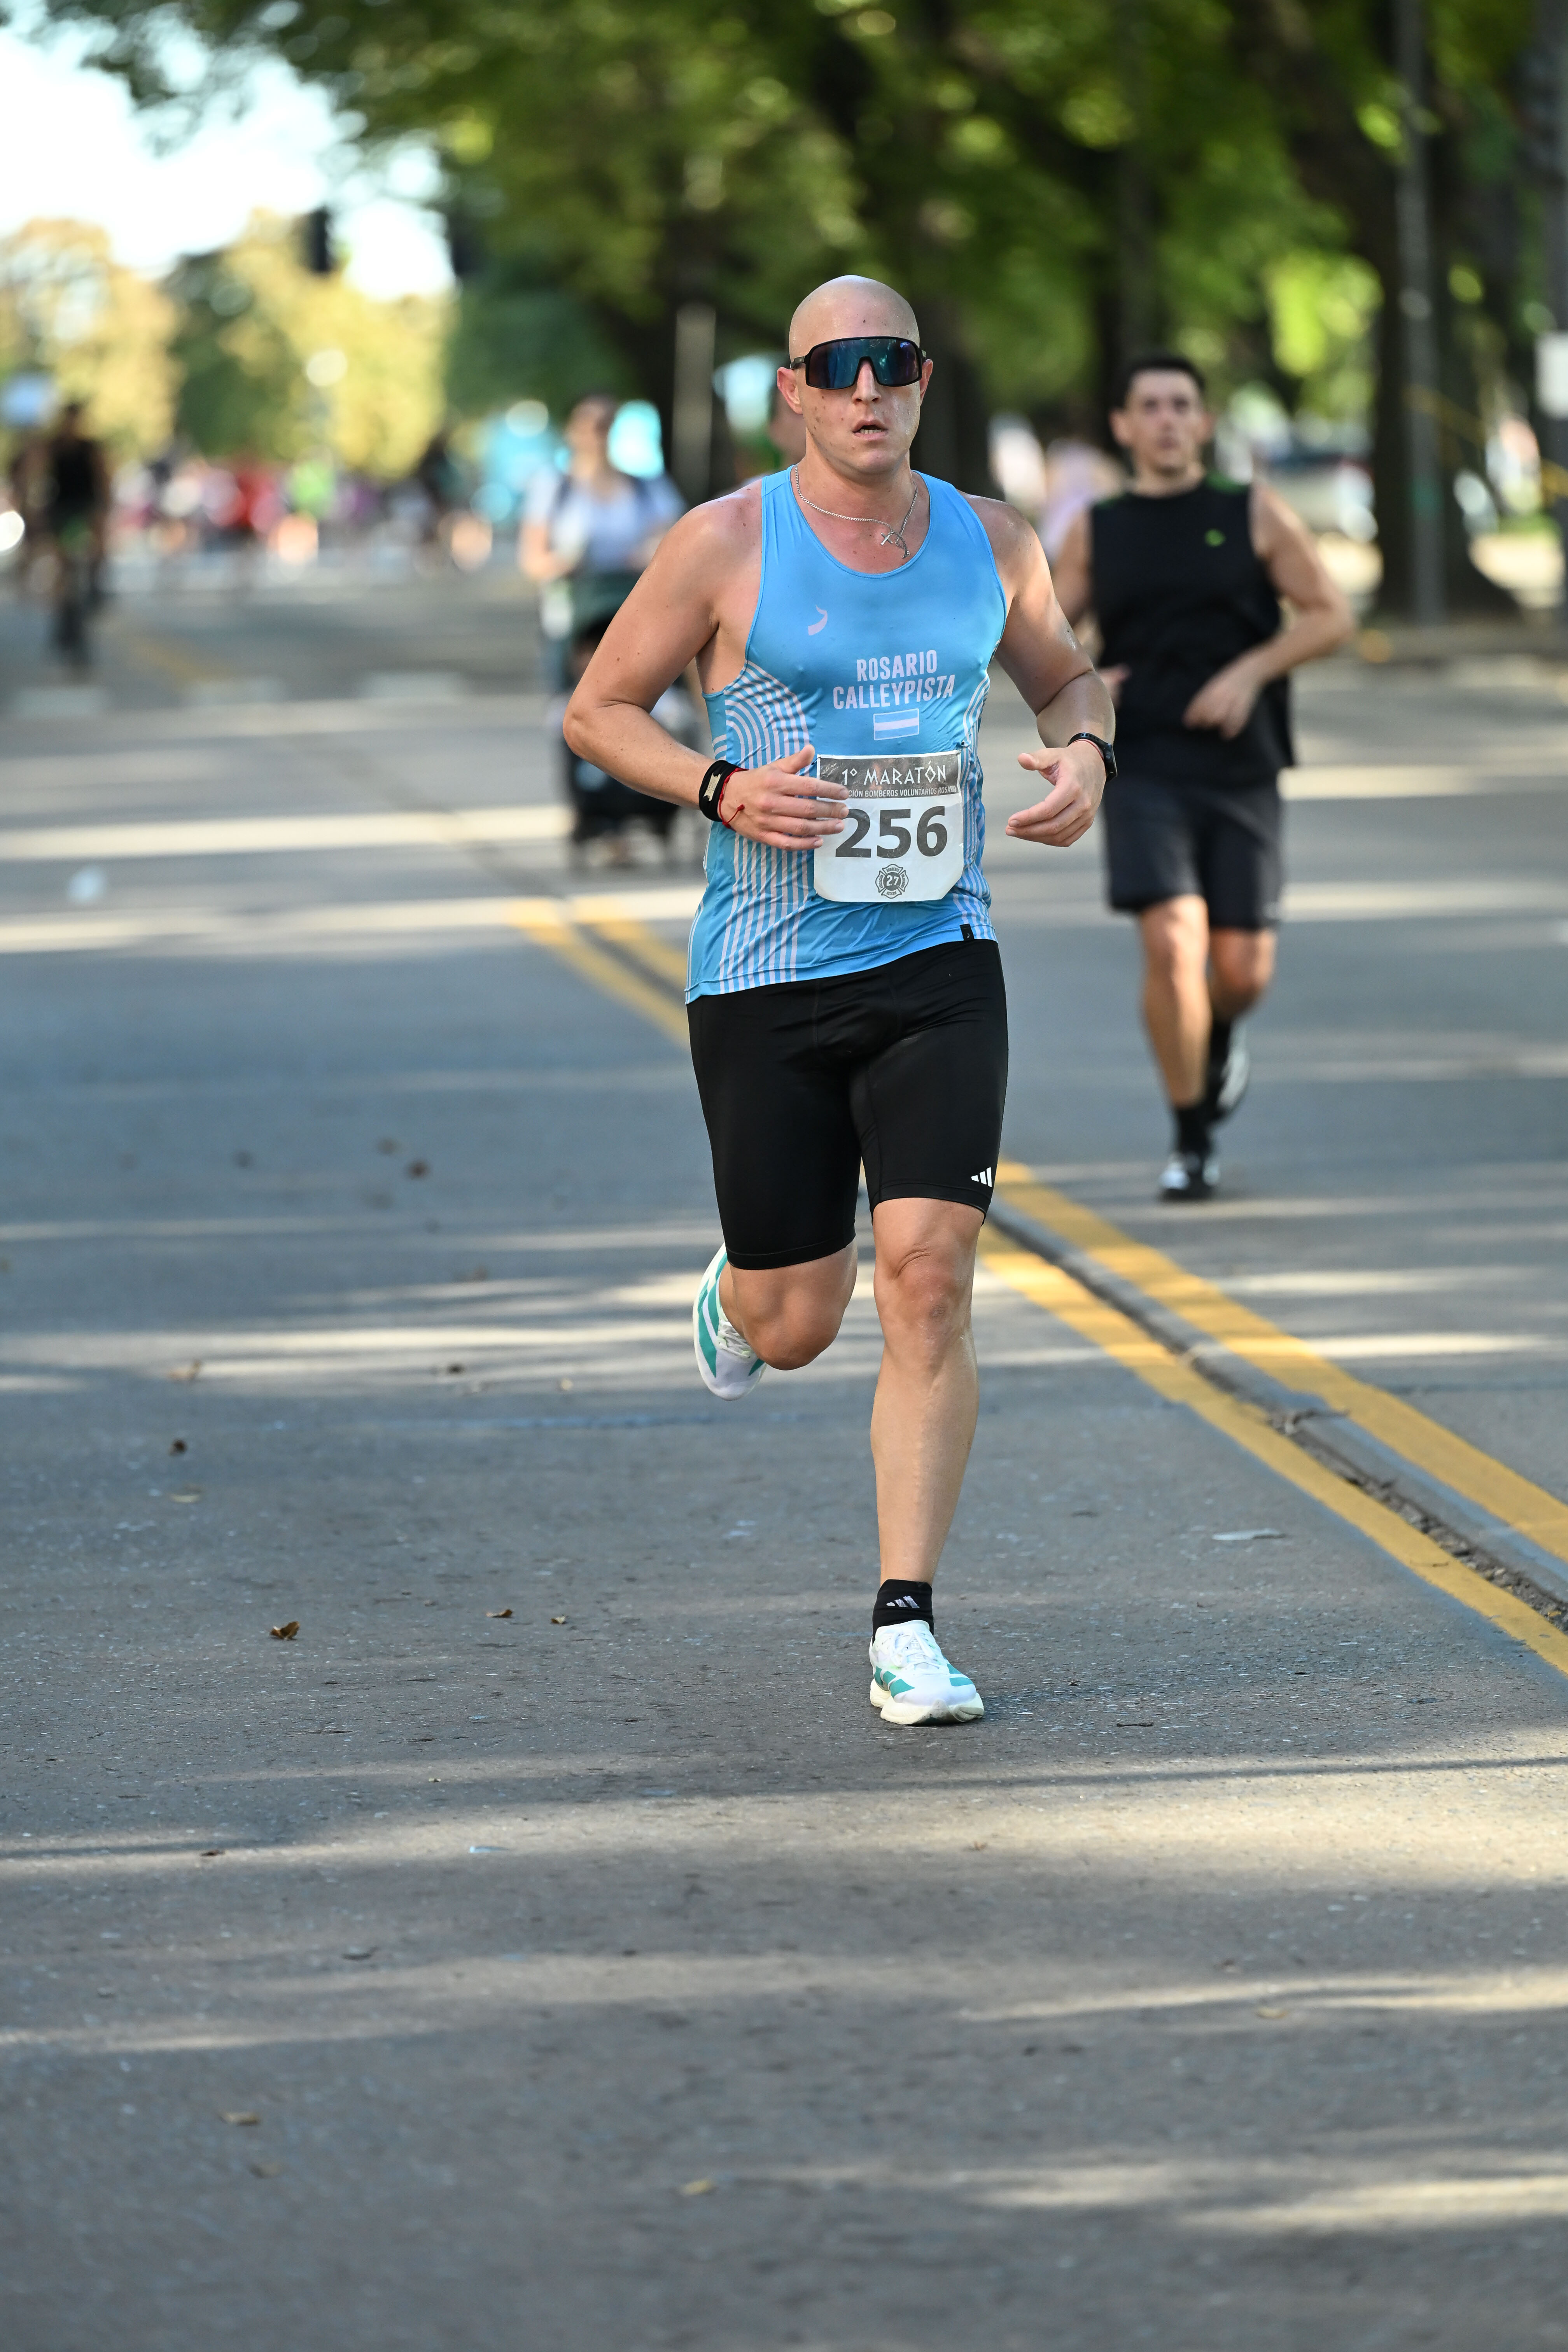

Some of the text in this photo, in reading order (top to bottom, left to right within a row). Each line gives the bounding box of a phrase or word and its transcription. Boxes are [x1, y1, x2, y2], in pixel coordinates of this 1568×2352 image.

[857, 650, 937, 681] ROSARIO
[833, 675, 955, 709] CALLEYPISTA
[863, 760, 946, 785] MARATÓN
[835, 806, 948, 859] 256
[887, 875, 899, 886] 27
